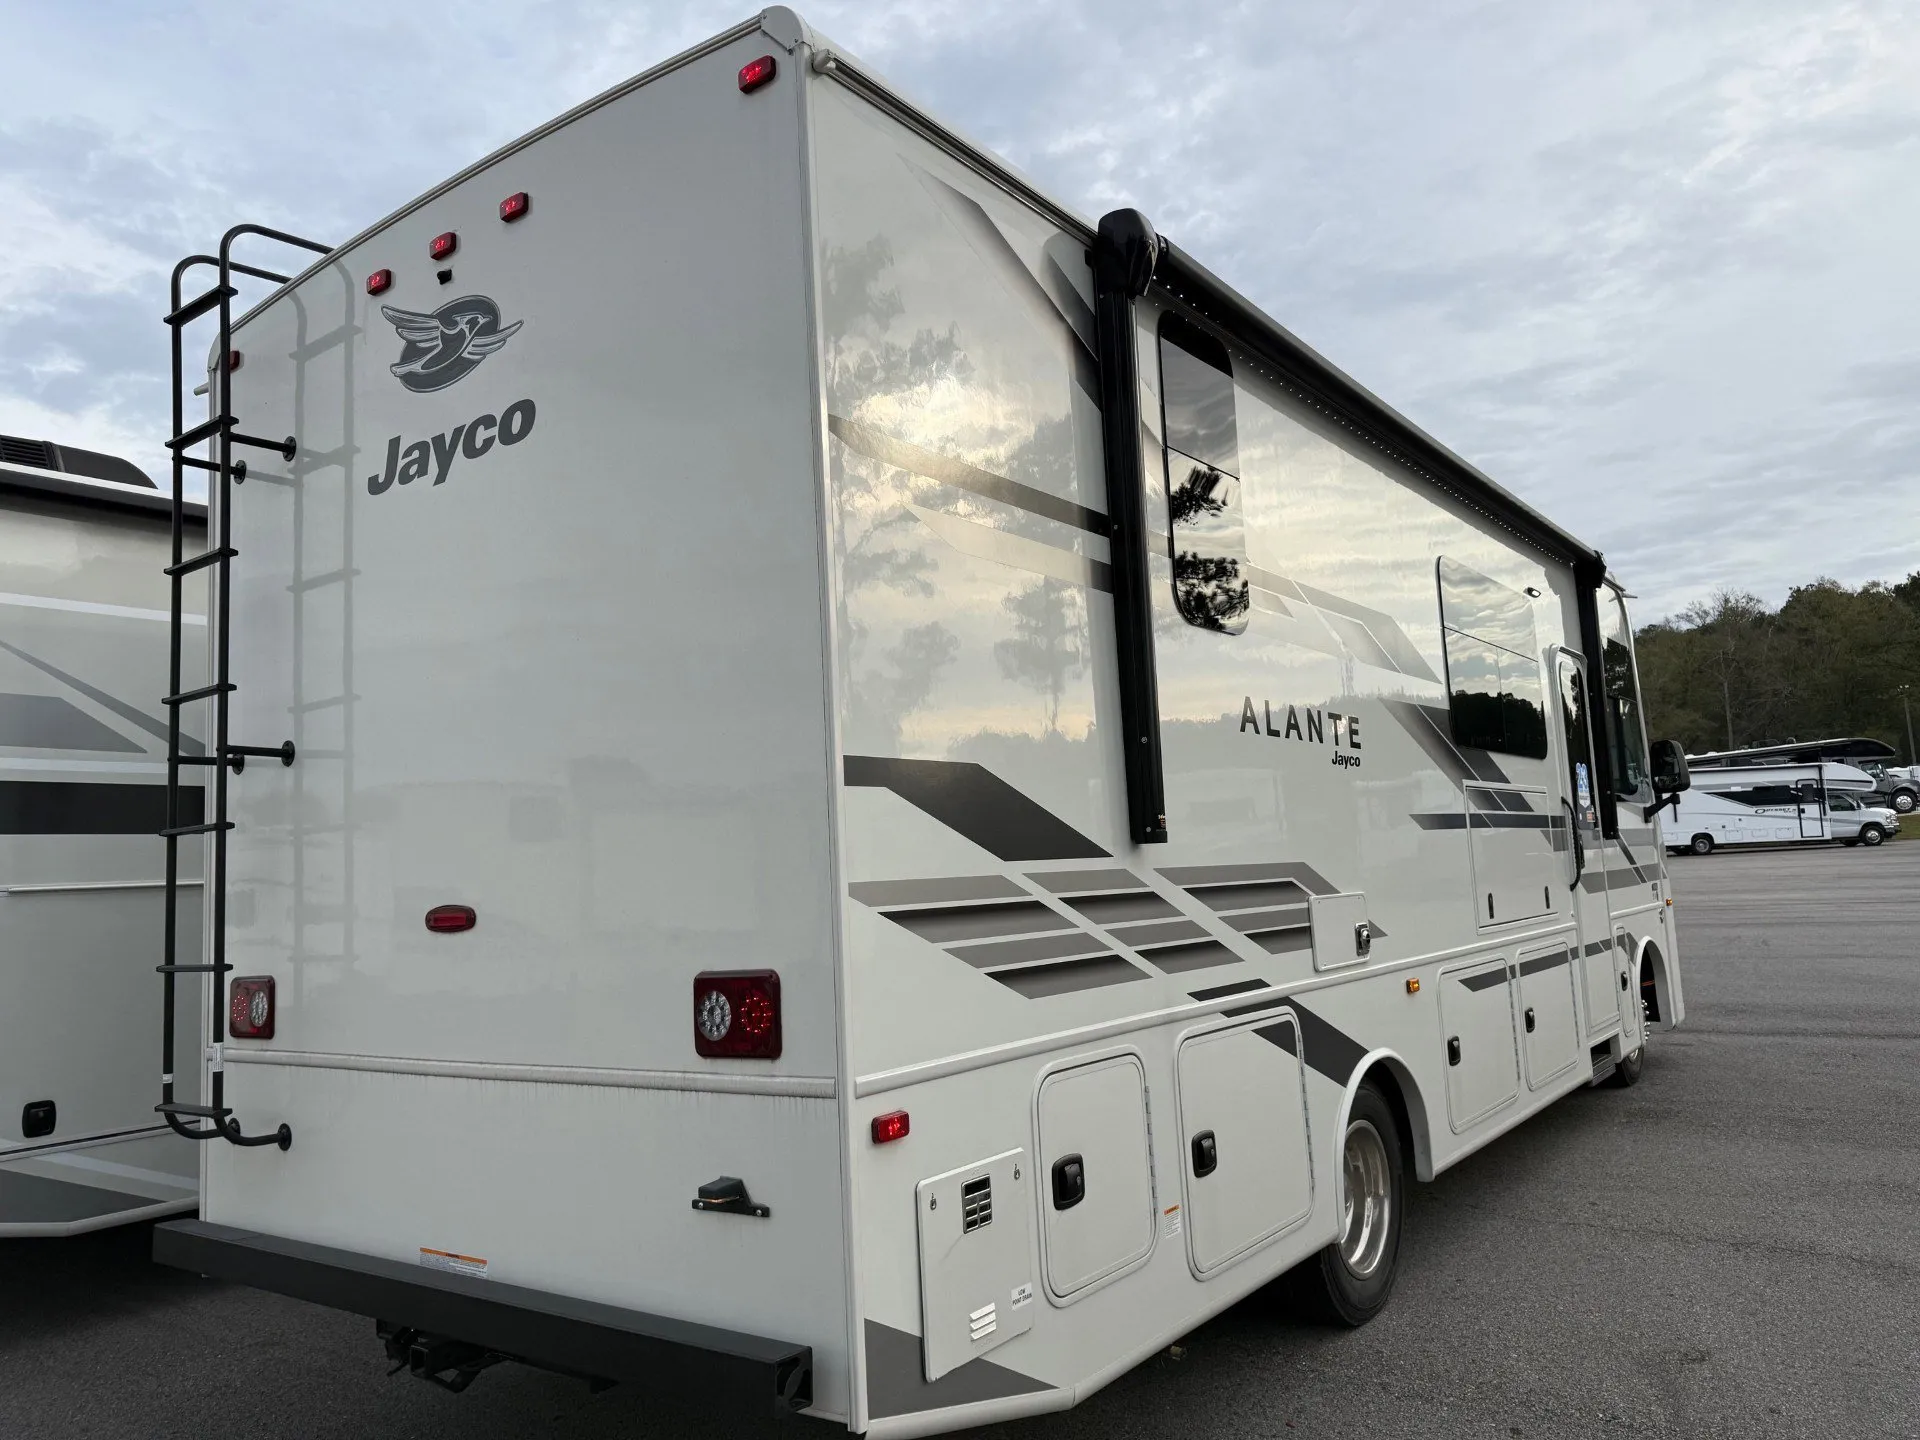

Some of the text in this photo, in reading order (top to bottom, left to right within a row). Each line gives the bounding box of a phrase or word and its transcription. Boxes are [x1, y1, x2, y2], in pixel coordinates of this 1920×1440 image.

[368, 399, 536, 495] Jayco
[1240, 696, 1361, 749] ALANTE
[1332, 750, 1361, 769] Jayco
